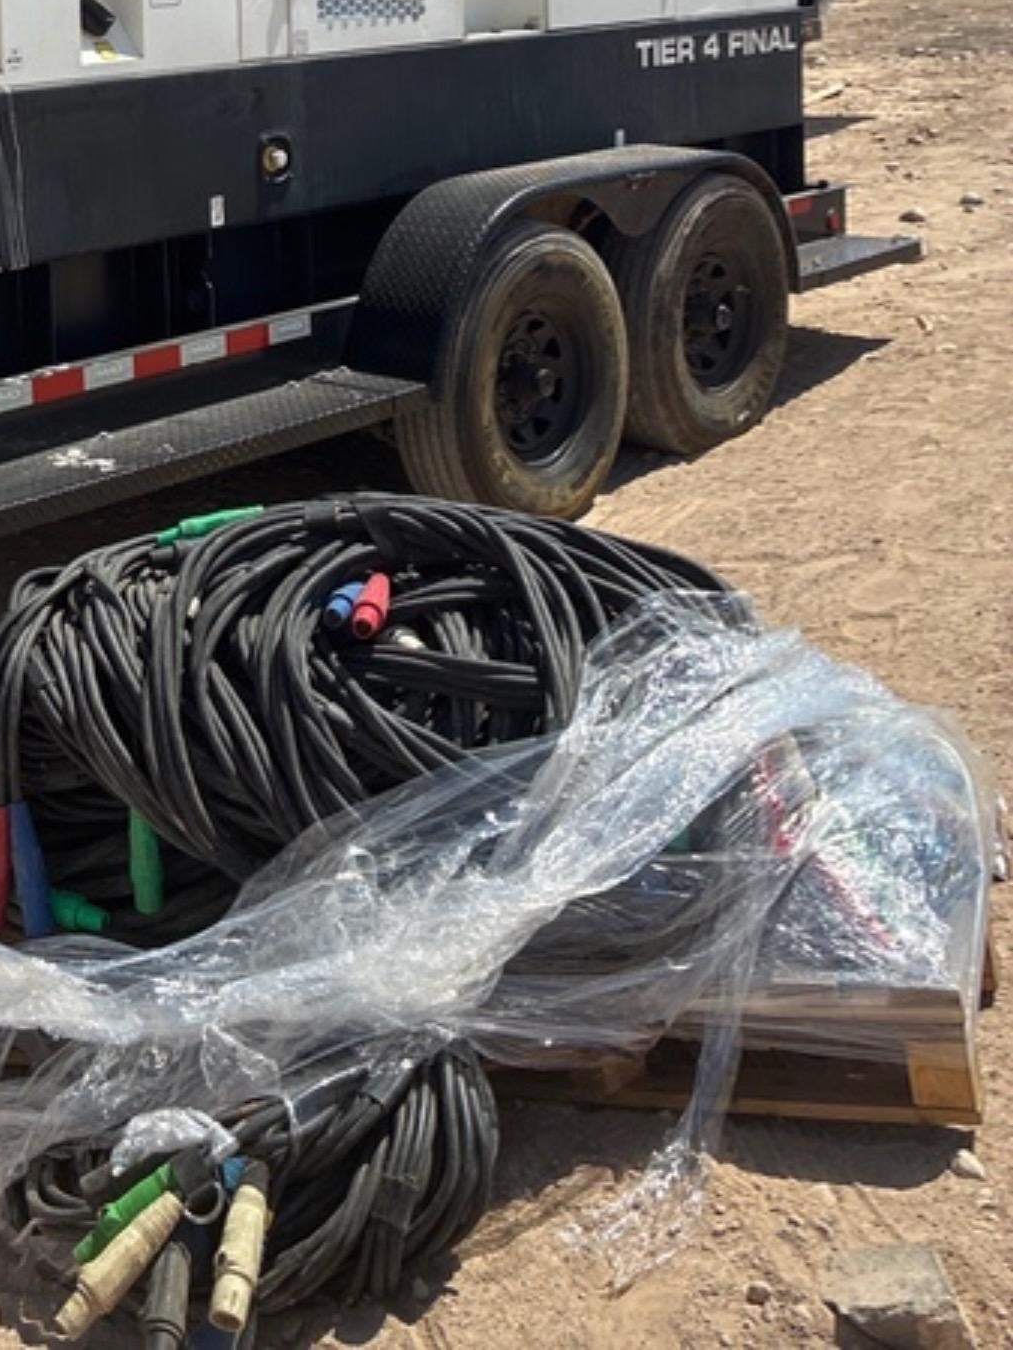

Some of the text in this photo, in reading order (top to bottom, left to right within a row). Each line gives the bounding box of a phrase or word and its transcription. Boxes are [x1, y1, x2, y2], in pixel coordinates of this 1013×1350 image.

[635, 25, 797, 68] TIER 4 FINAL
